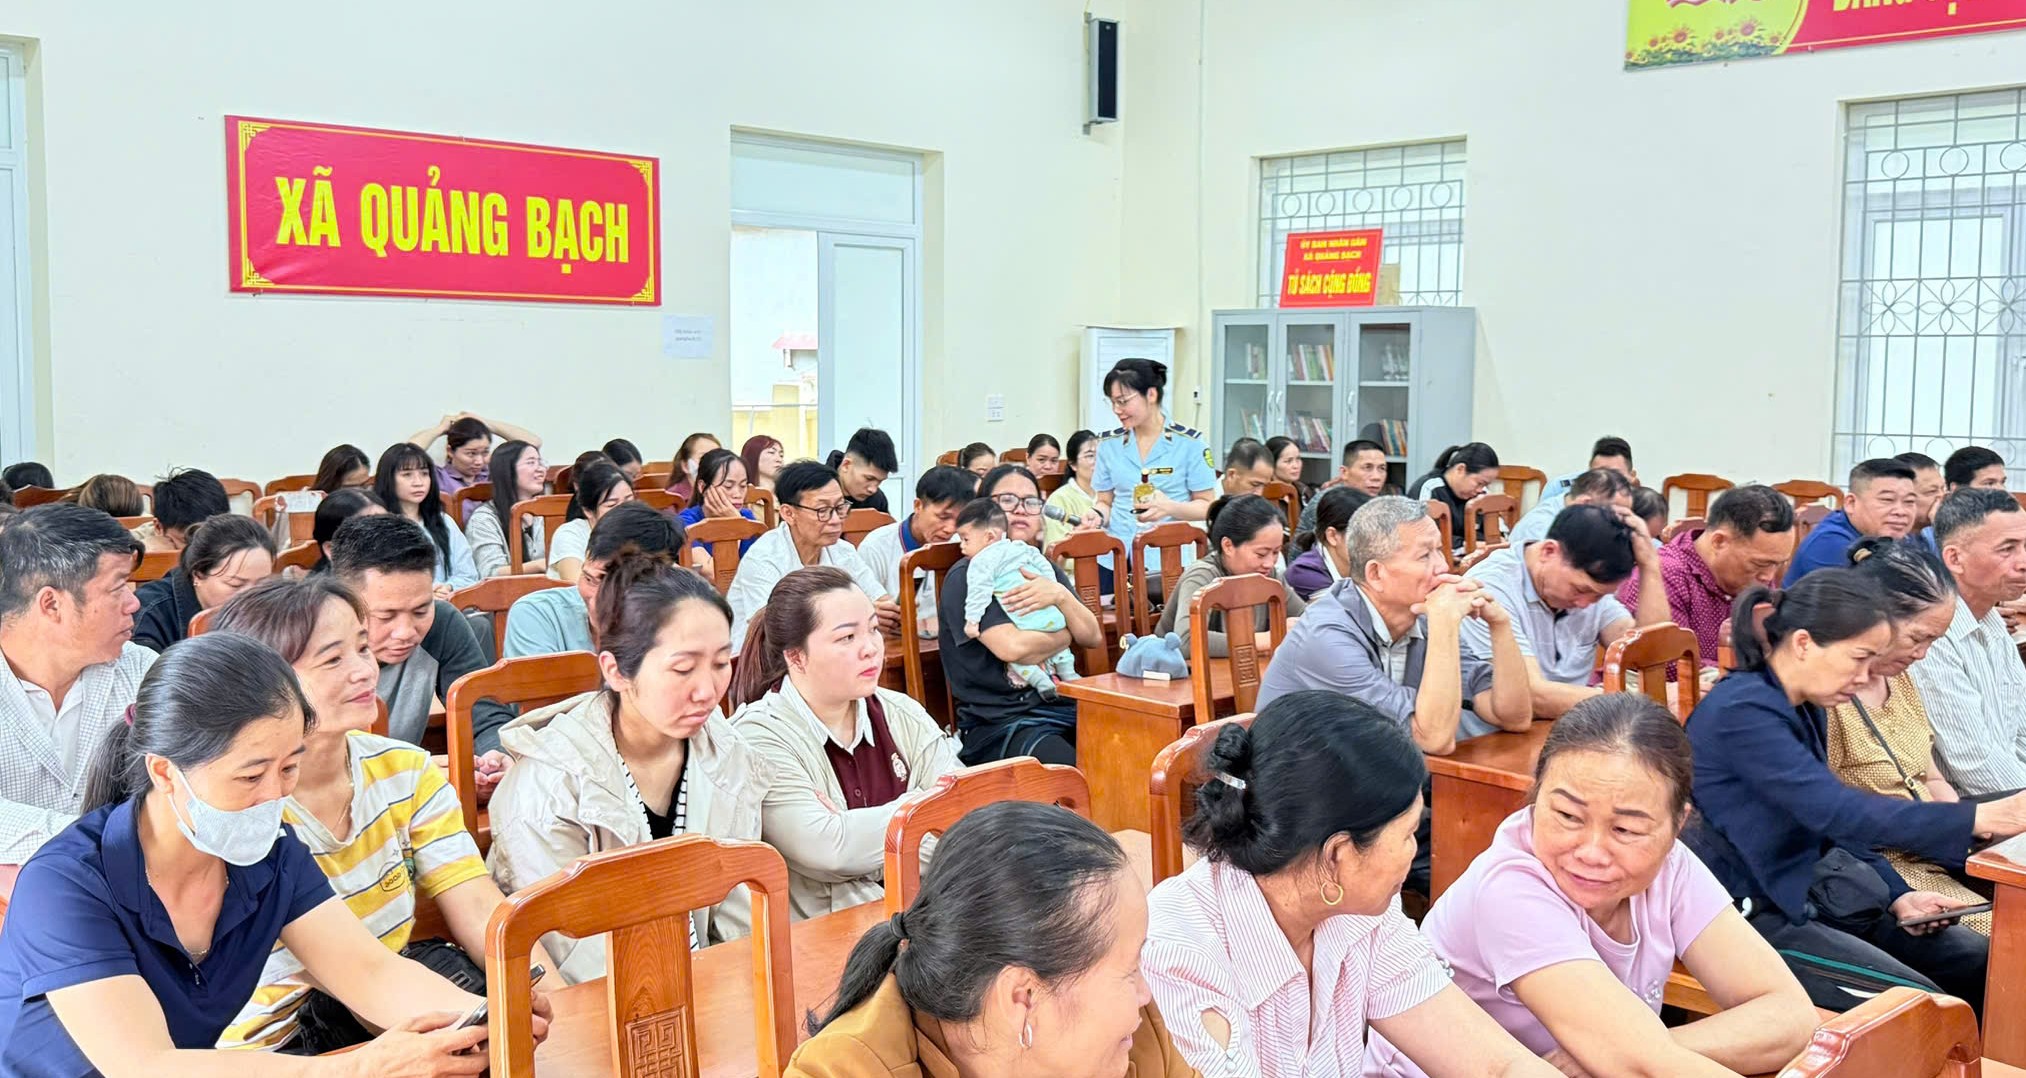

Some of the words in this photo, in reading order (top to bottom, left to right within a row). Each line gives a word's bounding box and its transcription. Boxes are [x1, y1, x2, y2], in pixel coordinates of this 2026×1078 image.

[275, 166, 341, 247] XÃ
[361, 165, 509, 257] QUẢNG
[527, 196, 630, 274] BẠCH
[1299, 270, 1323, 295] SÁCH
[1322, 269, 1347, 298] CỘNG
